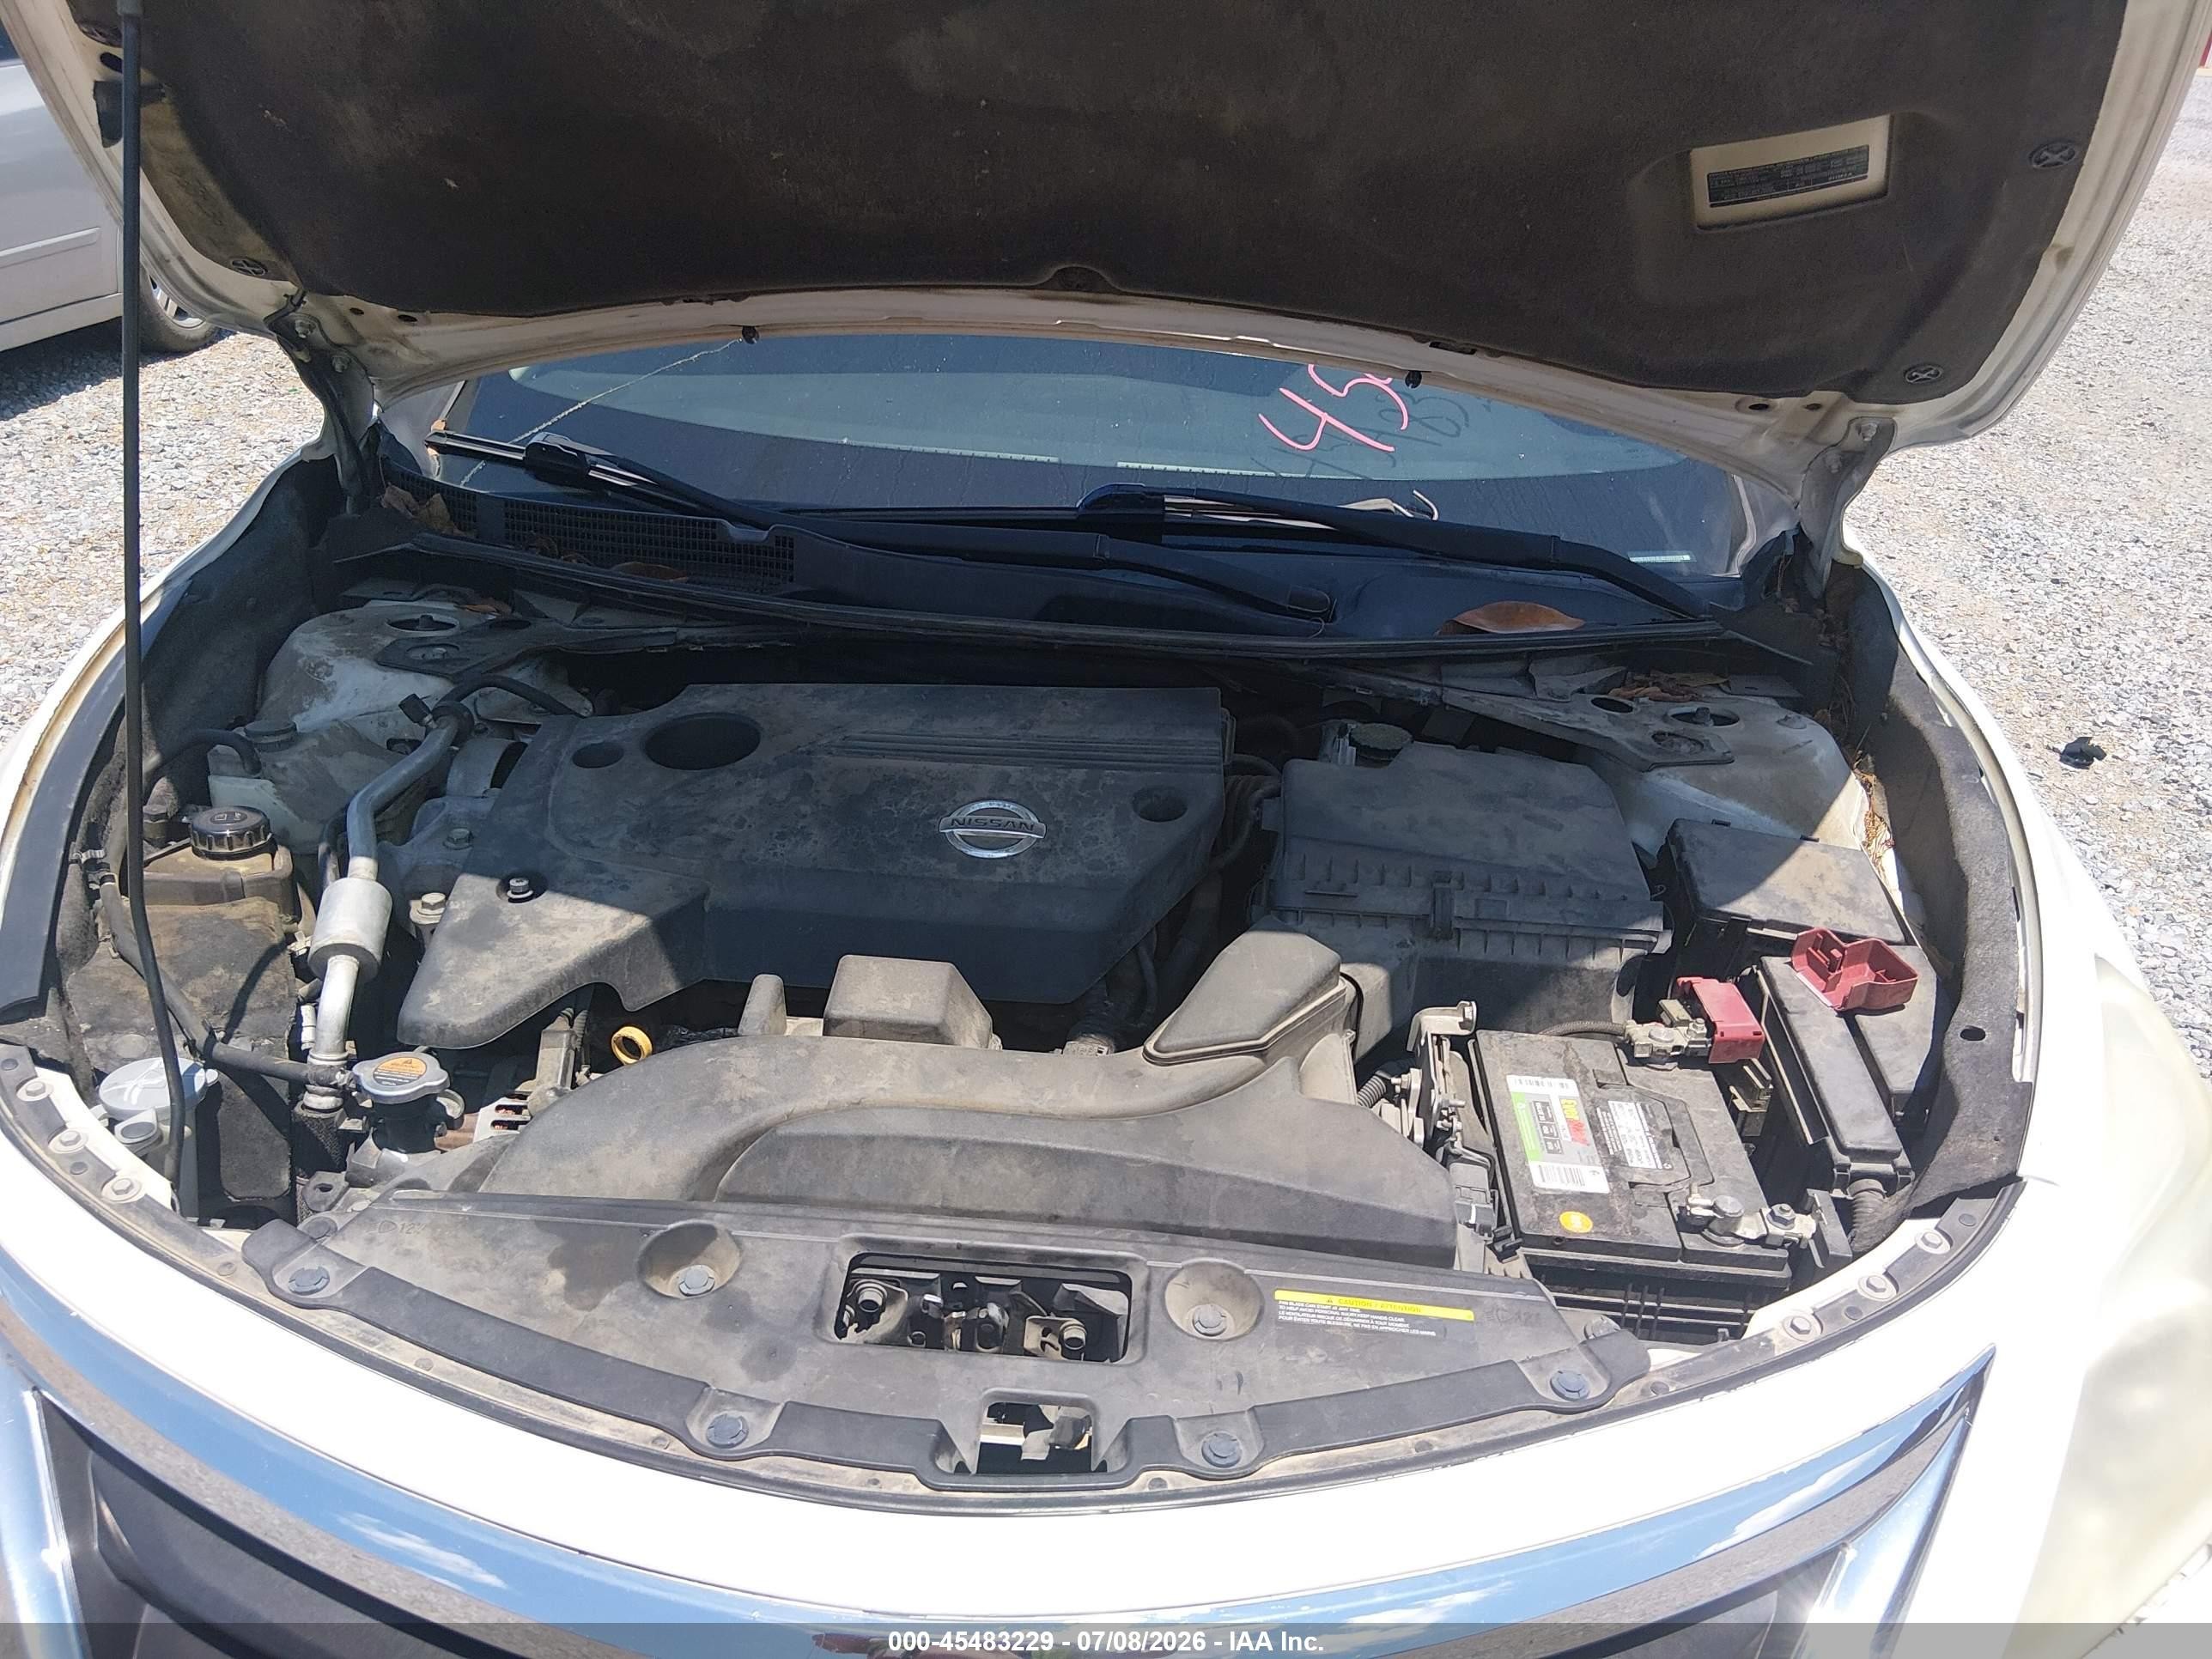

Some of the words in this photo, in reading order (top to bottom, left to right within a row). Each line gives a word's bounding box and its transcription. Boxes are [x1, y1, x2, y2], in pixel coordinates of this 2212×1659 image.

[1258, 363, 1409, 452] 45
[951, 817, 1035, 831] NISSAN
[1338, 1297, 1371, 1307] CAUTION
[1380, 1303, 1420, 1312] ATTENTION
